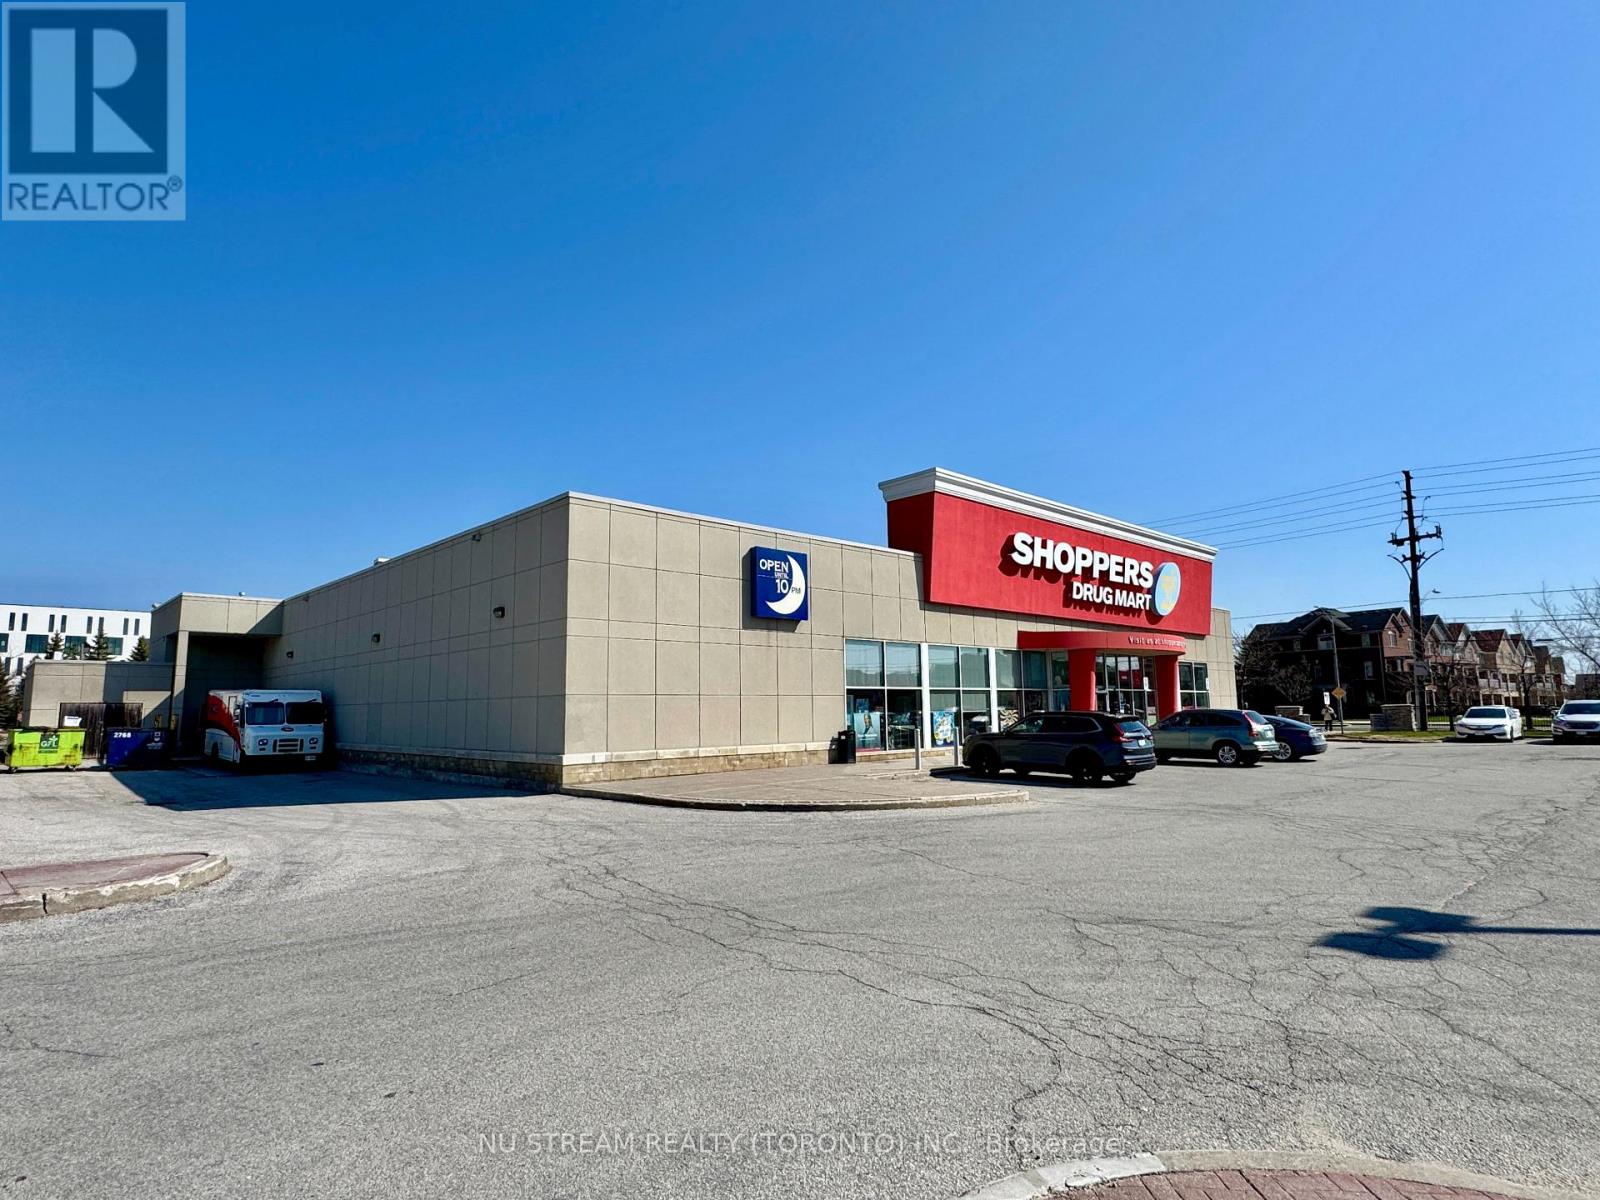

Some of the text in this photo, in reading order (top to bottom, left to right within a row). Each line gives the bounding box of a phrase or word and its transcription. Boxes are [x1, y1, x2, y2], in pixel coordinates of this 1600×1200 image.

[759, 558, 789, 573] OPEN
[1011, 532, 1154, 589] SHOPPERS
[774, 571, 789, 579] UNTIL
[775, 579, 801, 594] 10 PM
[1072, 581, 1152, 611] DRUG MART
[1128, 635, 1144, 645] Visit
